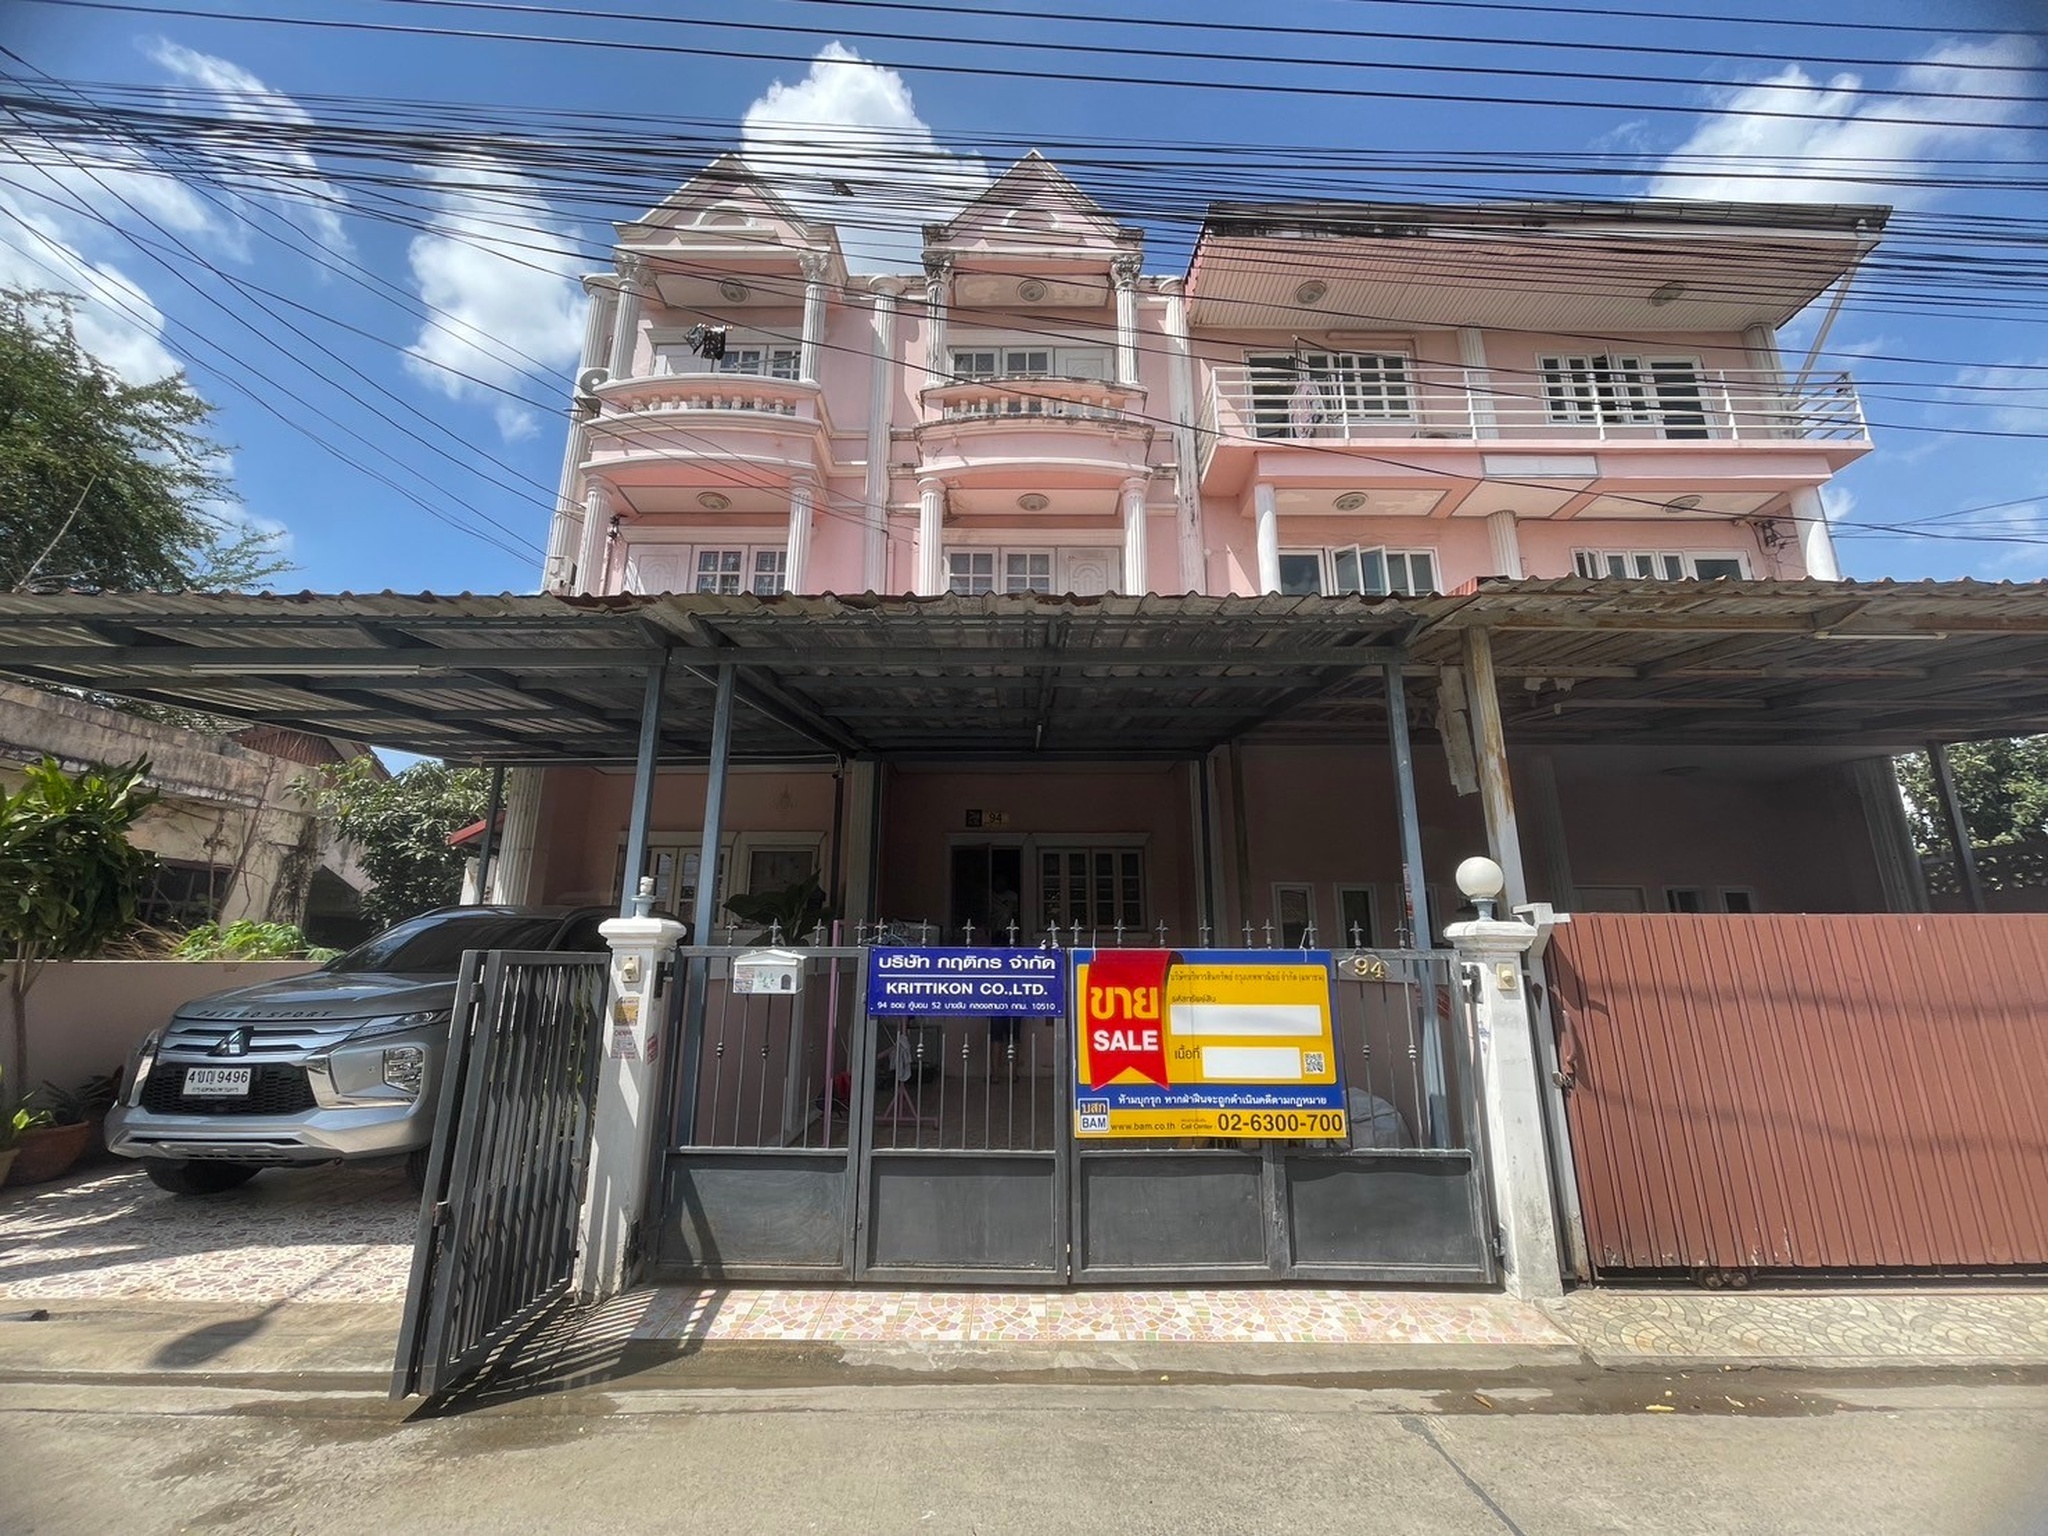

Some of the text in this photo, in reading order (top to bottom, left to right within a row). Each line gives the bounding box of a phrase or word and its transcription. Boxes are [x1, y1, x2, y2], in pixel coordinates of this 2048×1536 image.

[989, 811, 1003, 825] 94
[878, 953, 1056, 971] บริษัท กฤติกร จำกัด
[1354, 957, 1385, 979] 94
[886, 982, 1048, 996] KRITTIKON CO.,LTD.
[877, 1001, 887, 1010] 94
[932, 1001, 941, 1010] 52
[1032, 1002, 1056, 1011] 10510
[1090, 986, 1159, 1020] ขาย
[266, 1010, 333, 1018] SPORT
[1093, 1030, 1159, 1051] SALE
[1174, 1044, 1200, 1060] เนื้อที่
[217, 1070, 249, 1084] 9496
[1118, 1093, 1162, 1107] ห้ามบุกรุก
[1082, 1117, 1106, 1129] BAM
[1111, 1122, 1175, 1131] www.bam.co.th
[1218, 1113, 1343, 1132] 02-6300-700
